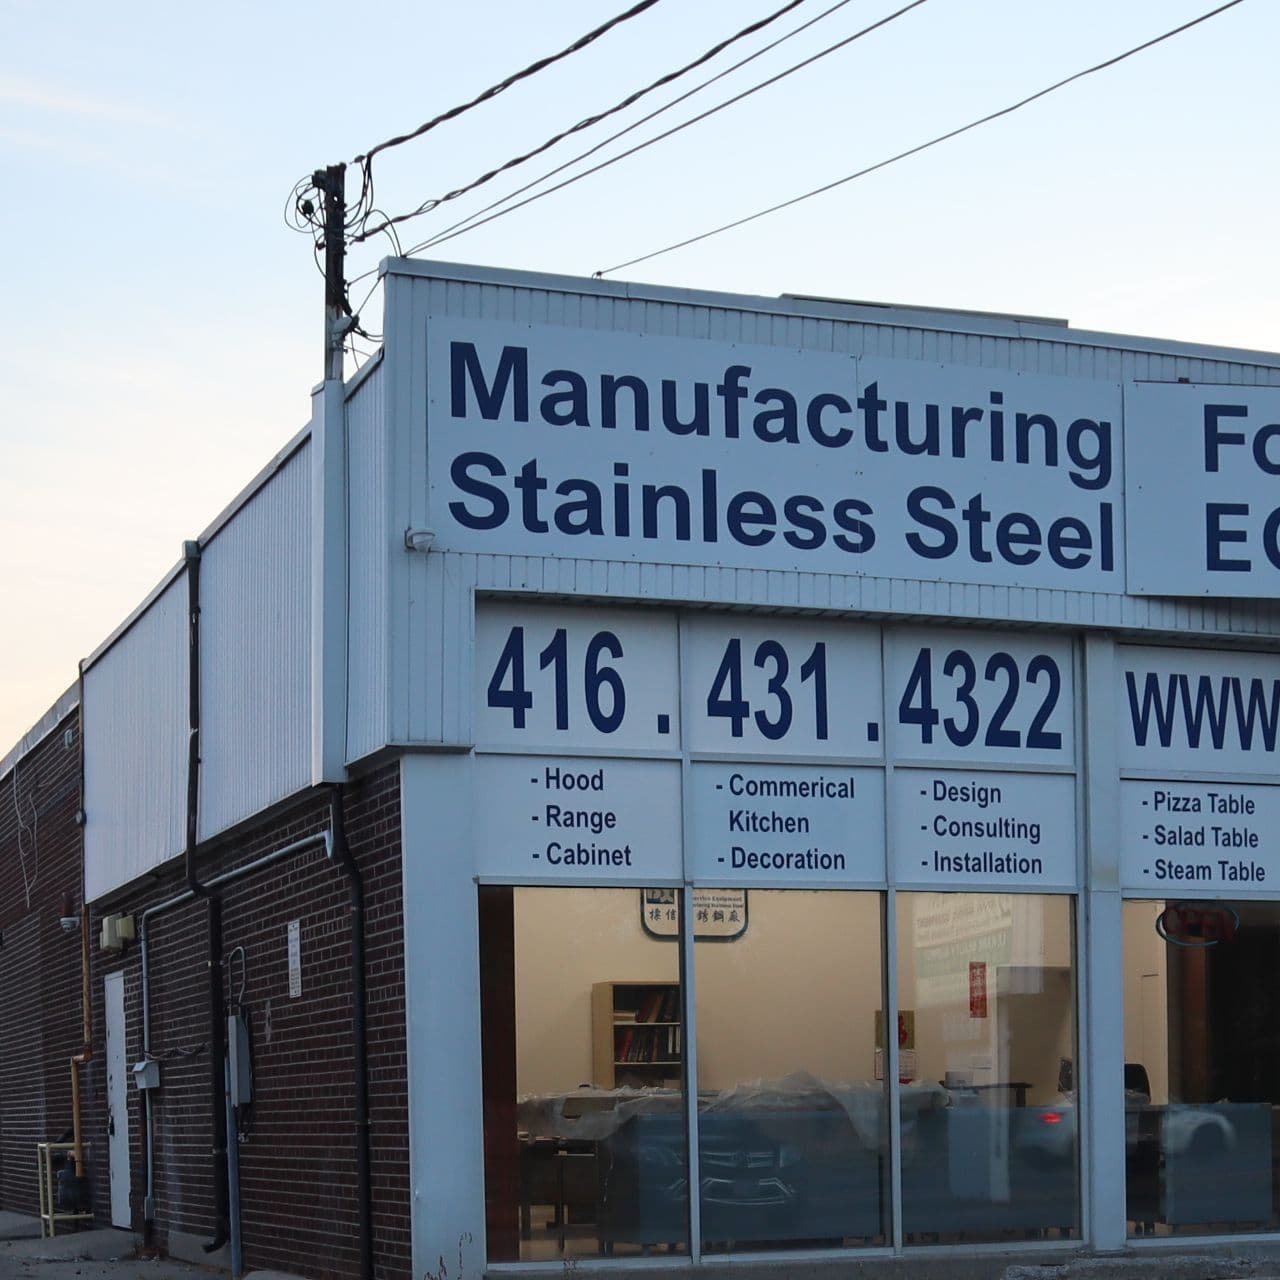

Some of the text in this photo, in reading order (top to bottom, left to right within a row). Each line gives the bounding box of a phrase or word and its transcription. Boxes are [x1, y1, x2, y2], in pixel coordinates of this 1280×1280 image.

[450, 341, 1113, 490] Manufacturing
[448, 451, 1114, 572] Stainless Steel
[898, 648, 1062, 749] 4322
[545, 767, 604, 792] Hood
[729, 773, 855, 799] Commerical
[933, 780, 1002, 808] Design
[1153, 790, 1256, 815] Pizza Table
[545, 804, 617, 834] Range
[729, 809, 810, 834] Kitchen
[933, 815, 1041, 844] Consulting
[1154, 825, 1259, 849] Salad Table
[546, 841, 632, 867] Cabinet
[731, 846, 846, 871] Decoration
[933, 850, 1043, 875] Installation
[1154, 858, 1266, 882] Steam Table
